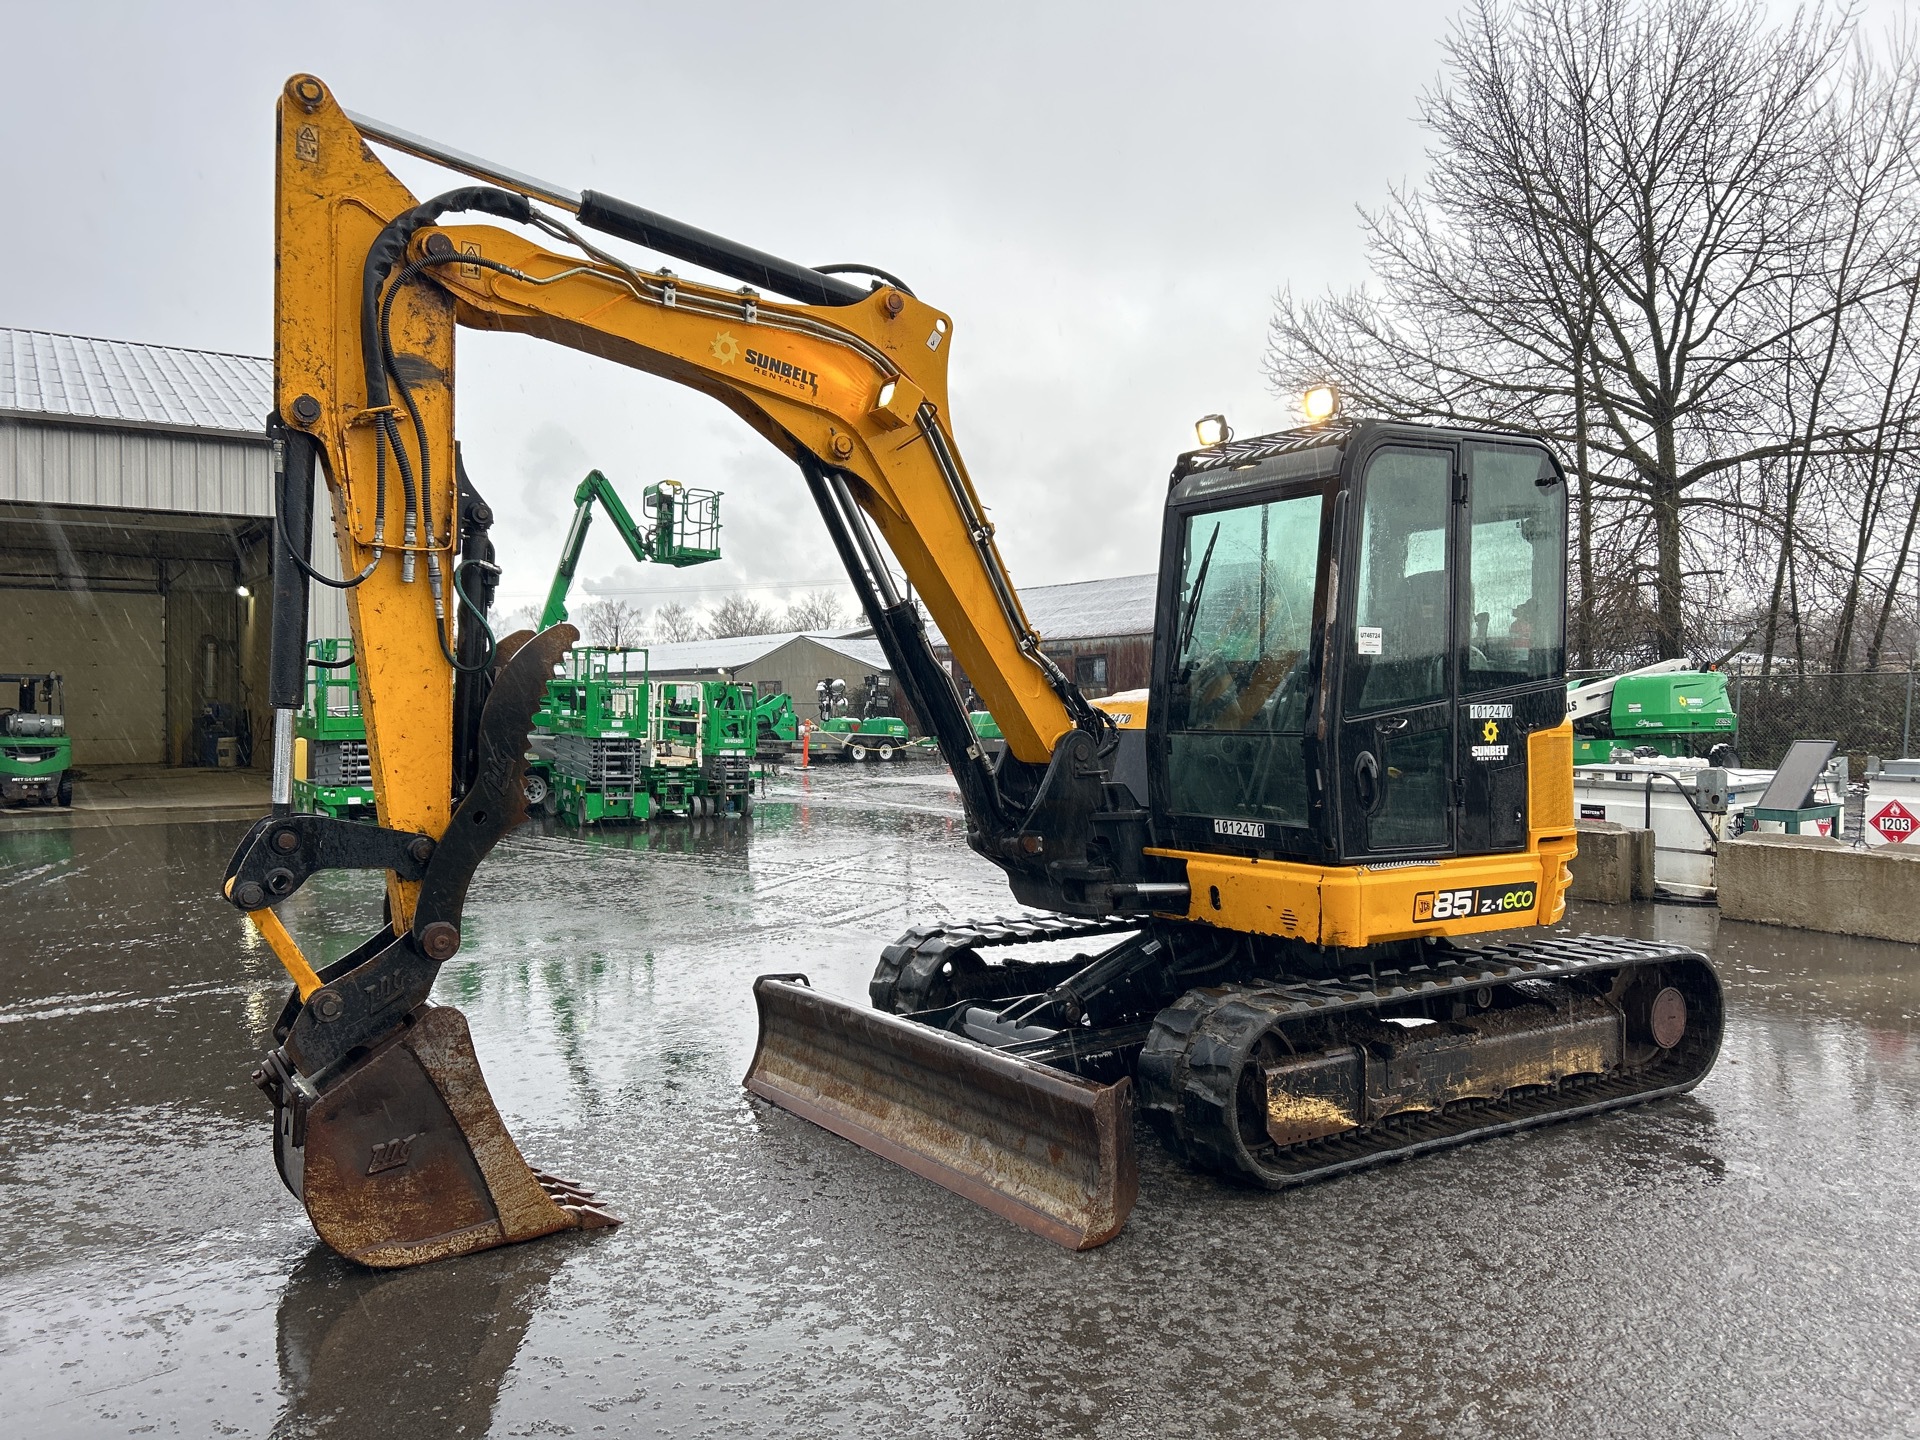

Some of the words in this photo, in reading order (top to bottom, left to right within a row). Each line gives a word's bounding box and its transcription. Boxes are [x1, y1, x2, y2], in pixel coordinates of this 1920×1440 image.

[745, 349, 818, 386] SUNBELT
[753, 367, 806, 390] RENTALS
[1471, 705, 1512, 718] 1012470
[1472, 745, 1509, 757] SUNBELT
[1215, 820, 1264, 837] 1012470
[1881, 818, 1910, 831] 1203
[1433, 890, 1472, 918] 85
